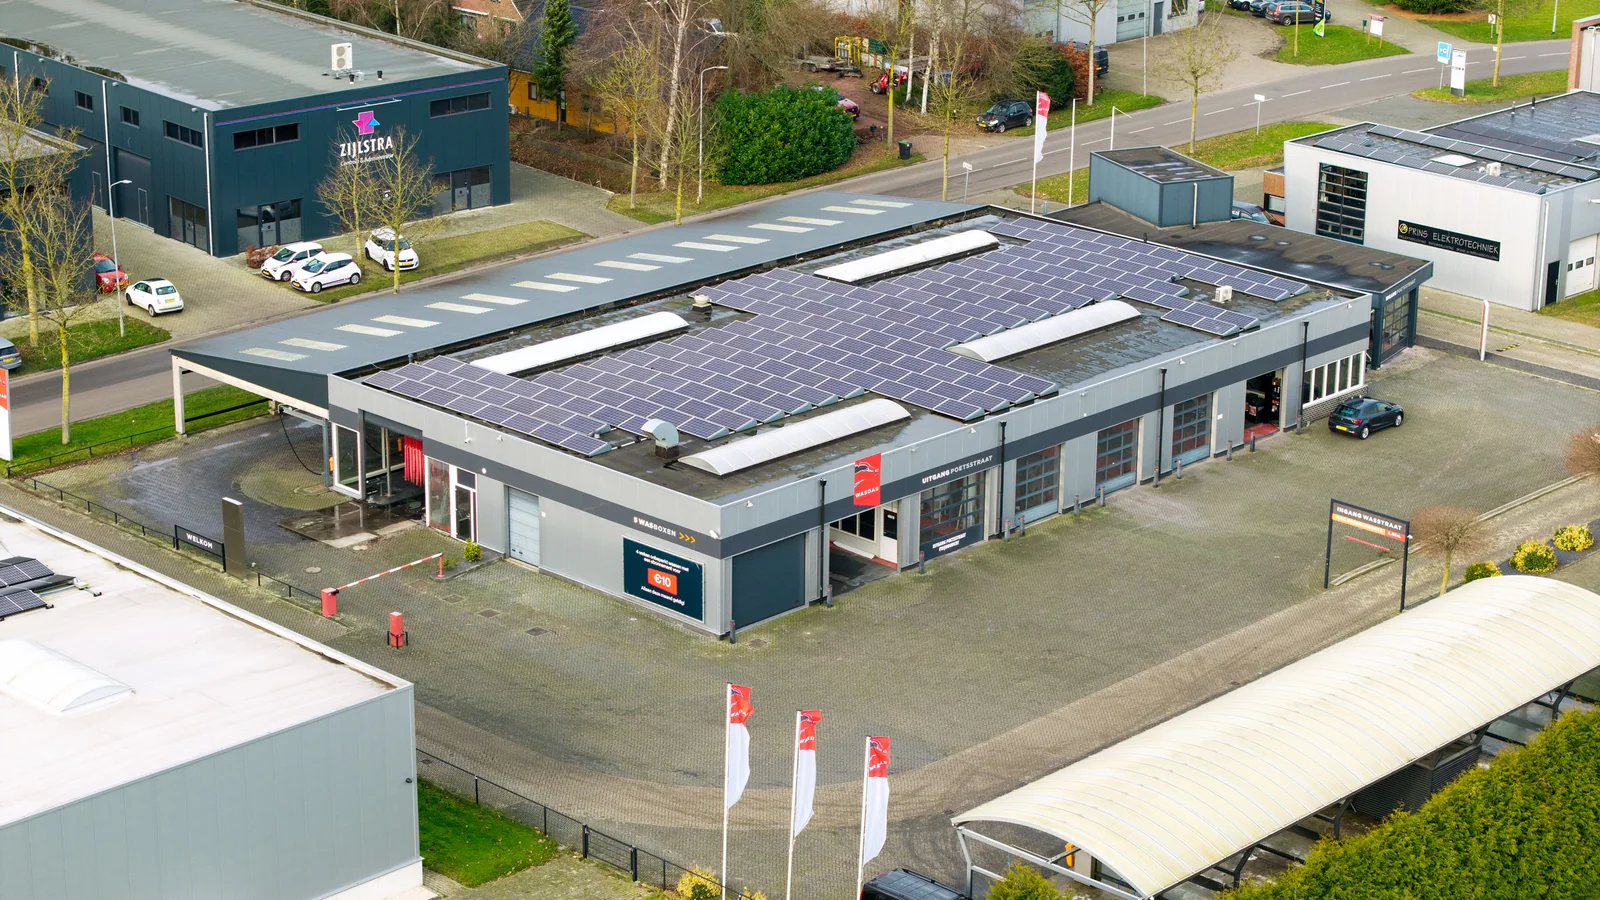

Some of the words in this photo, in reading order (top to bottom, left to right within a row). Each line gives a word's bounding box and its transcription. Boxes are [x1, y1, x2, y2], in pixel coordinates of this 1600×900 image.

[340, 136, 393, 158] ZIJLSTRA
[1408, 227, 1428, 239] PRINS
[1432, 232, 1499, 254] ELEKTROTECHNIEK
[921, 469, 950, 484] UITGANG
[950, 455, 993, 474] POETSSTRAAT
[855, 486, 879, 498] WASDAS
[638, 517, 677, 537] WASBOXEN
[1336, 506, 1362, 519] INGANG
[1362, 514, 1403, 531] WASSTRAAT
[186, 532, 213, 549] WELKOM
[653, 573, 671, 588] €10
